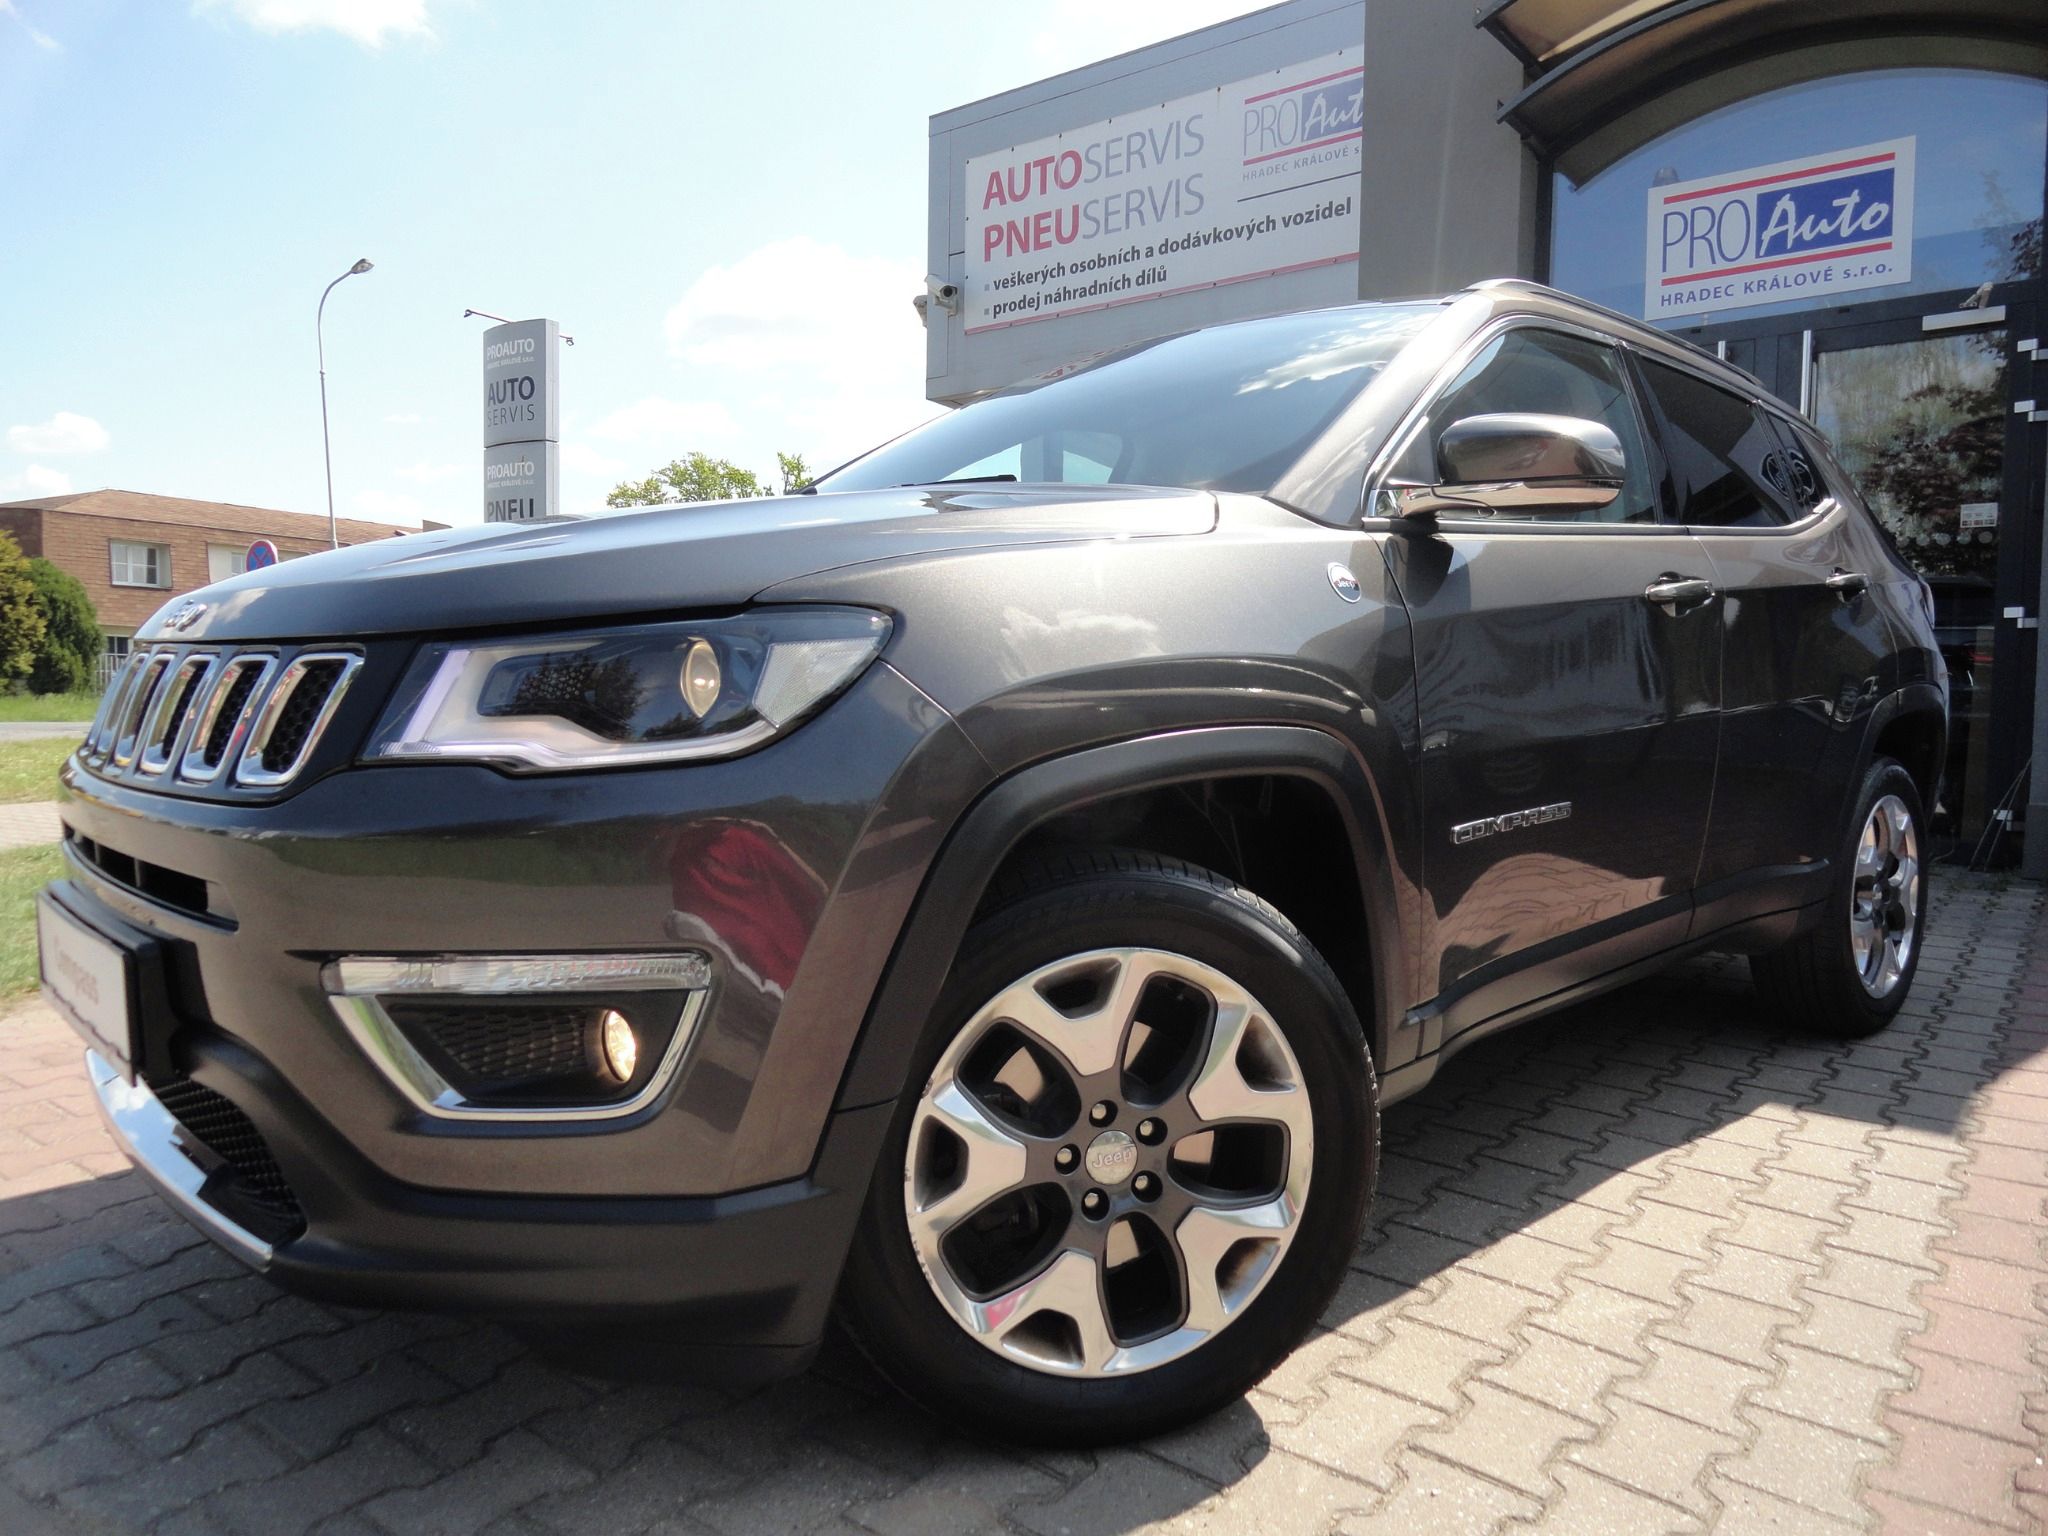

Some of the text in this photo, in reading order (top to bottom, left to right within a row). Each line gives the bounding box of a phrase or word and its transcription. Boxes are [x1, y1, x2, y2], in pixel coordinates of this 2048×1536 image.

[1303, 87, 1363, 141] Aut
[983, 114, 1205, 210] AUTOSERVIS
[1242, 162, 1289, 182] HRADEC
[1294, 146, 1349, 170] KRÁLOVÉ
[984, 173, 1205, 263] PNEUSERVIS
[993, 196, 1352, 291] veškerých osobních a dodávkových vozidel
[993, 265, 1167, 319] prodej náhradních dílů
[1660, 262, 1893, 307] HRADEC KRÁLOVÉ s.r.o.
[486, 337, 535, 361] PROAUTO
[487, 375, 535, 407] AUTO
[487, 403, 535, 428] SERVIS
[487, 461, 535, 481] PROAUTO
[1450, 801, 1572, 844] COMPASS
[1092, 1147, 1133, 1169] Jeep
